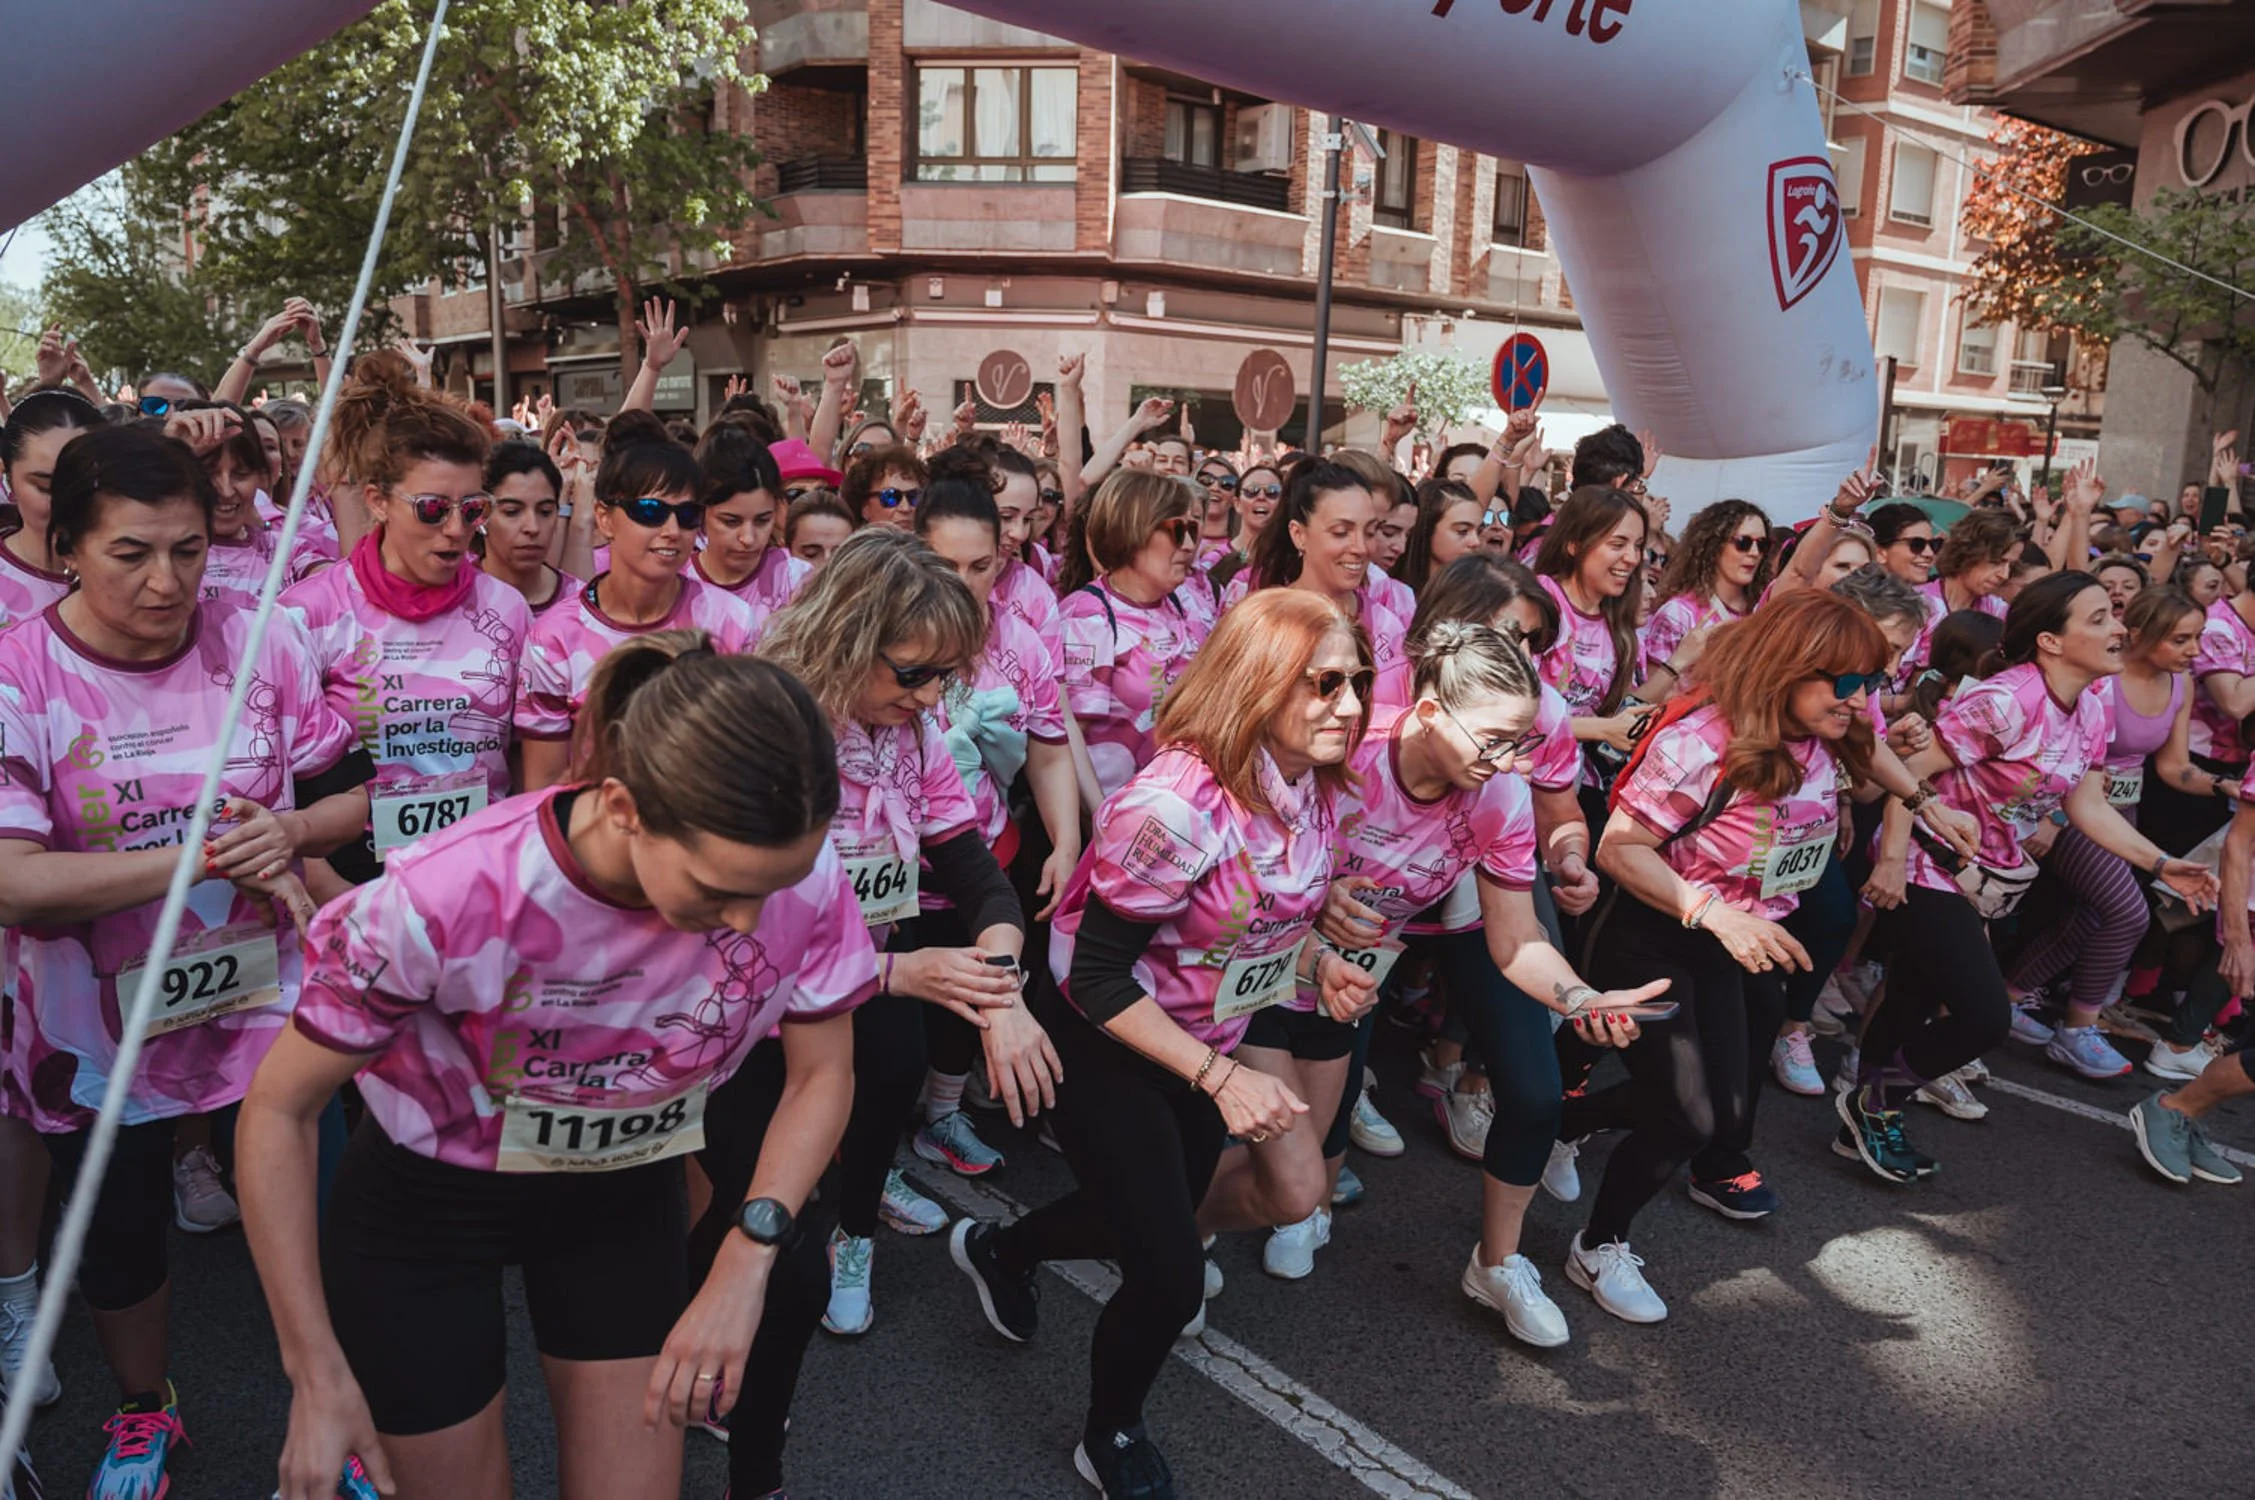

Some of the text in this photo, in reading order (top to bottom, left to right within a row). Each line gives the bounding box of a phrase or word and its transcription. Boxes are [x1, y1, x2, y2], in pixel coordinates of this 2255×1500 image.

[204, 586, 219, 598] XI
[381, 675, 404, 690] XI
[384, 697, 468, 713] Carrera
[385, 717, 445, 741] por la
[112, 778, 145, 805] XI
[120, 797, 228, 833] Carrea
[398, 795, 470, 836] 6787
[1774, 804, 1789, 820] XI
[1344, 852, 1365, 872] XI
[1776, 843, 1825, 878] 6031
[846, 860, 907, 902] 464
[1254, 891, 1276, 912] XI
[162, 954, 240, 1008] 922
[527, 1028, 562, 1050] XI
[527, 1097, 688, 1150] 11198
